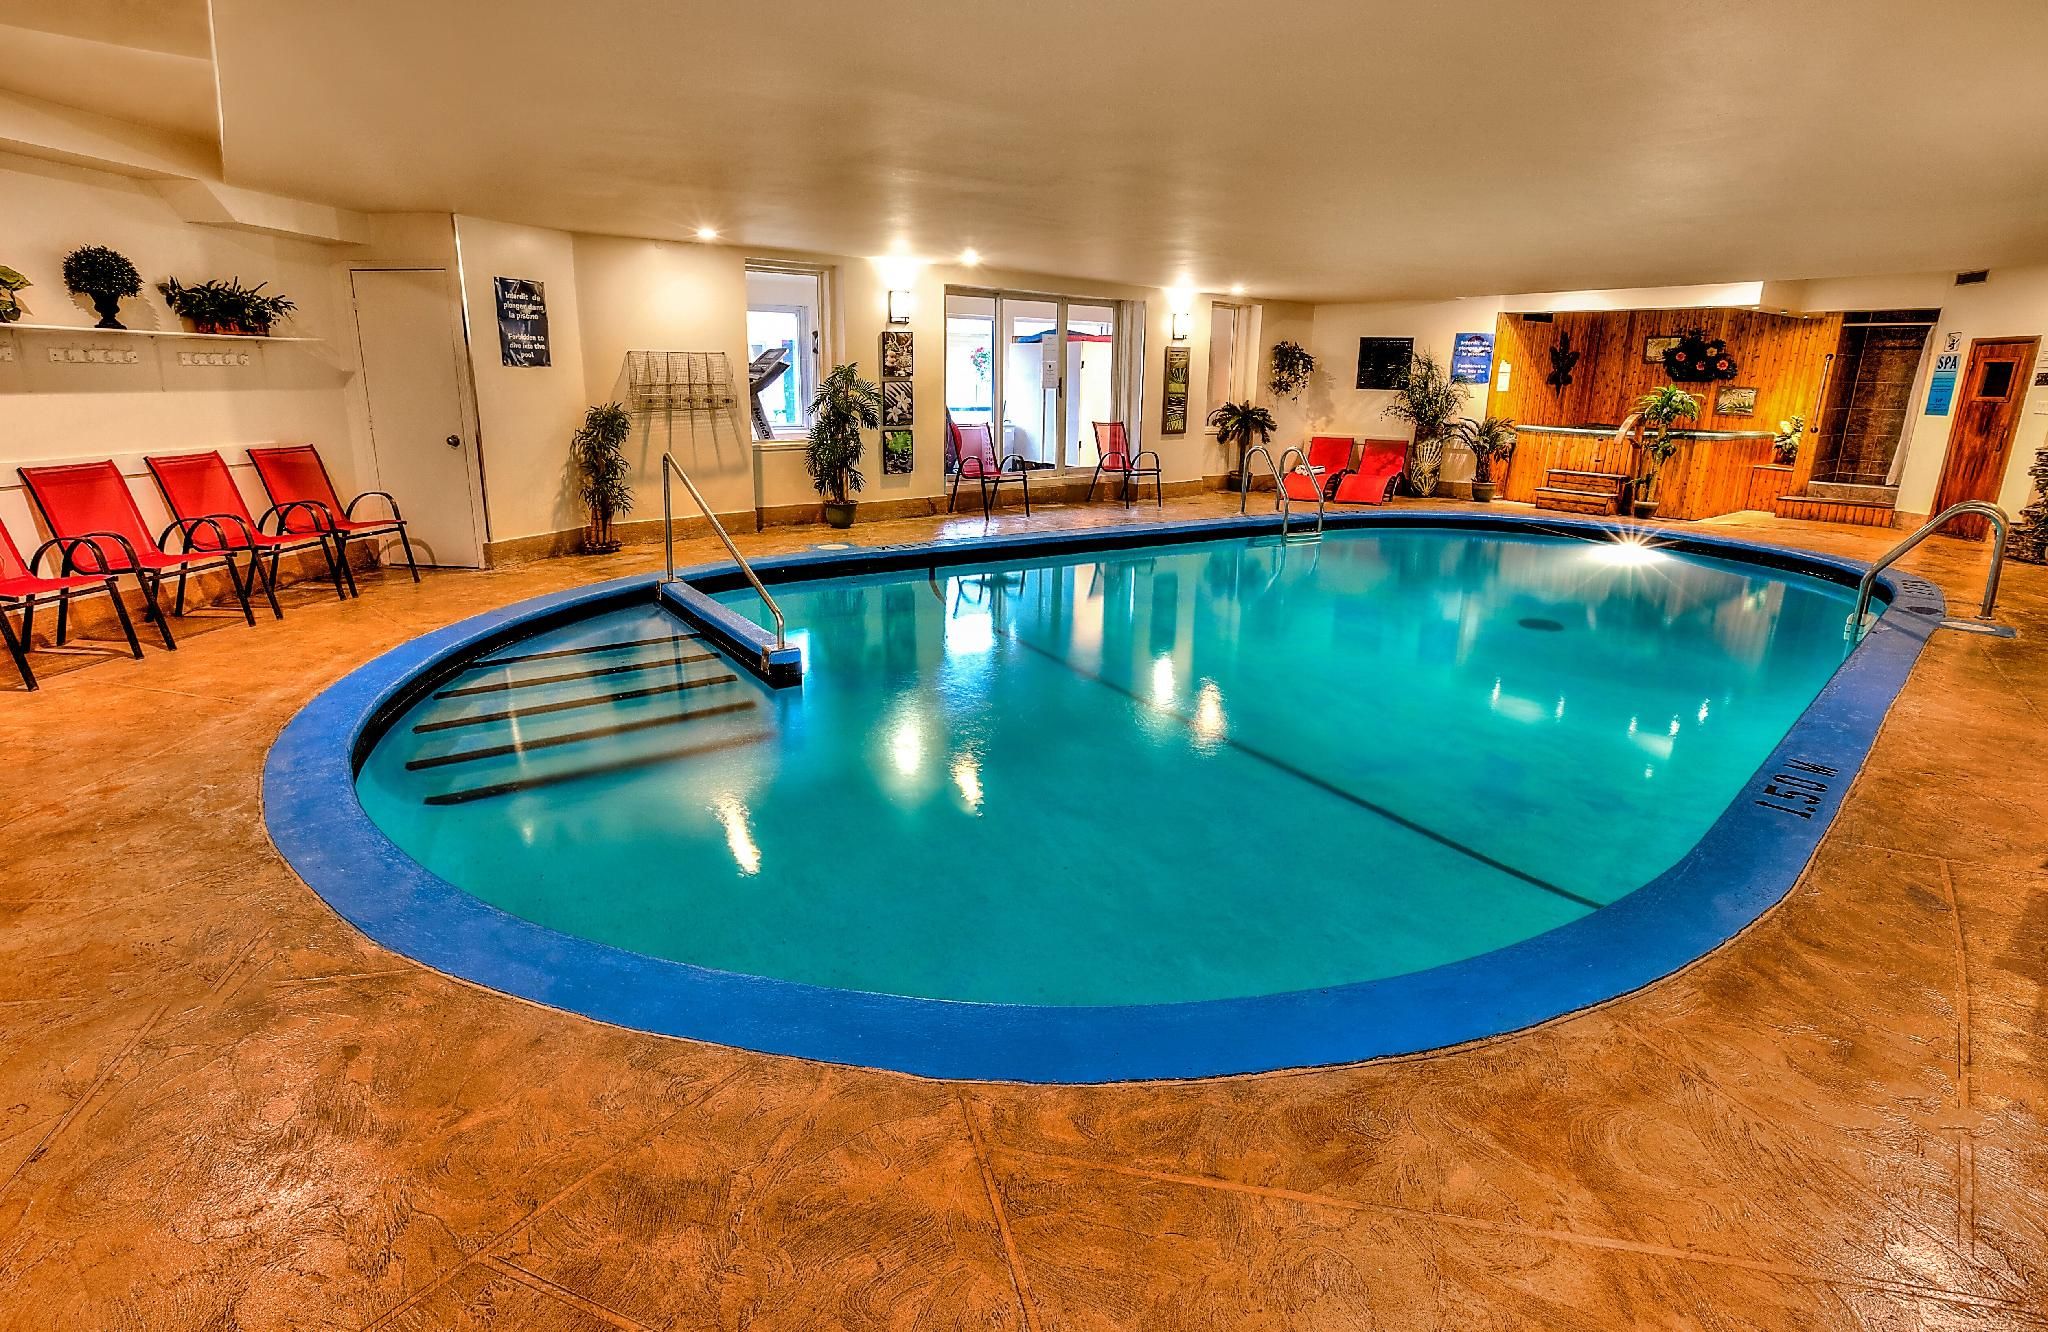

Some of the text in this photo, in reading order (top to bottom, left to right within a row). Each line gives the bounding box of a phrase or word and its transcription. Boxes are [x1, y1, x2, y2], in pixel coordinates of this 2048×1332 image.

[504, 291, 541, 301] Interdit de
[503, 301, 544, 311] plonger dans
[508, 311, 539, 320] la piscine
[508, 333, 537, 341] Forbidden
[520, 351, 535, 359] pool
[1937, 355, 1958, 370] SPA
[1754, 773, 1829, 820] 1.50
